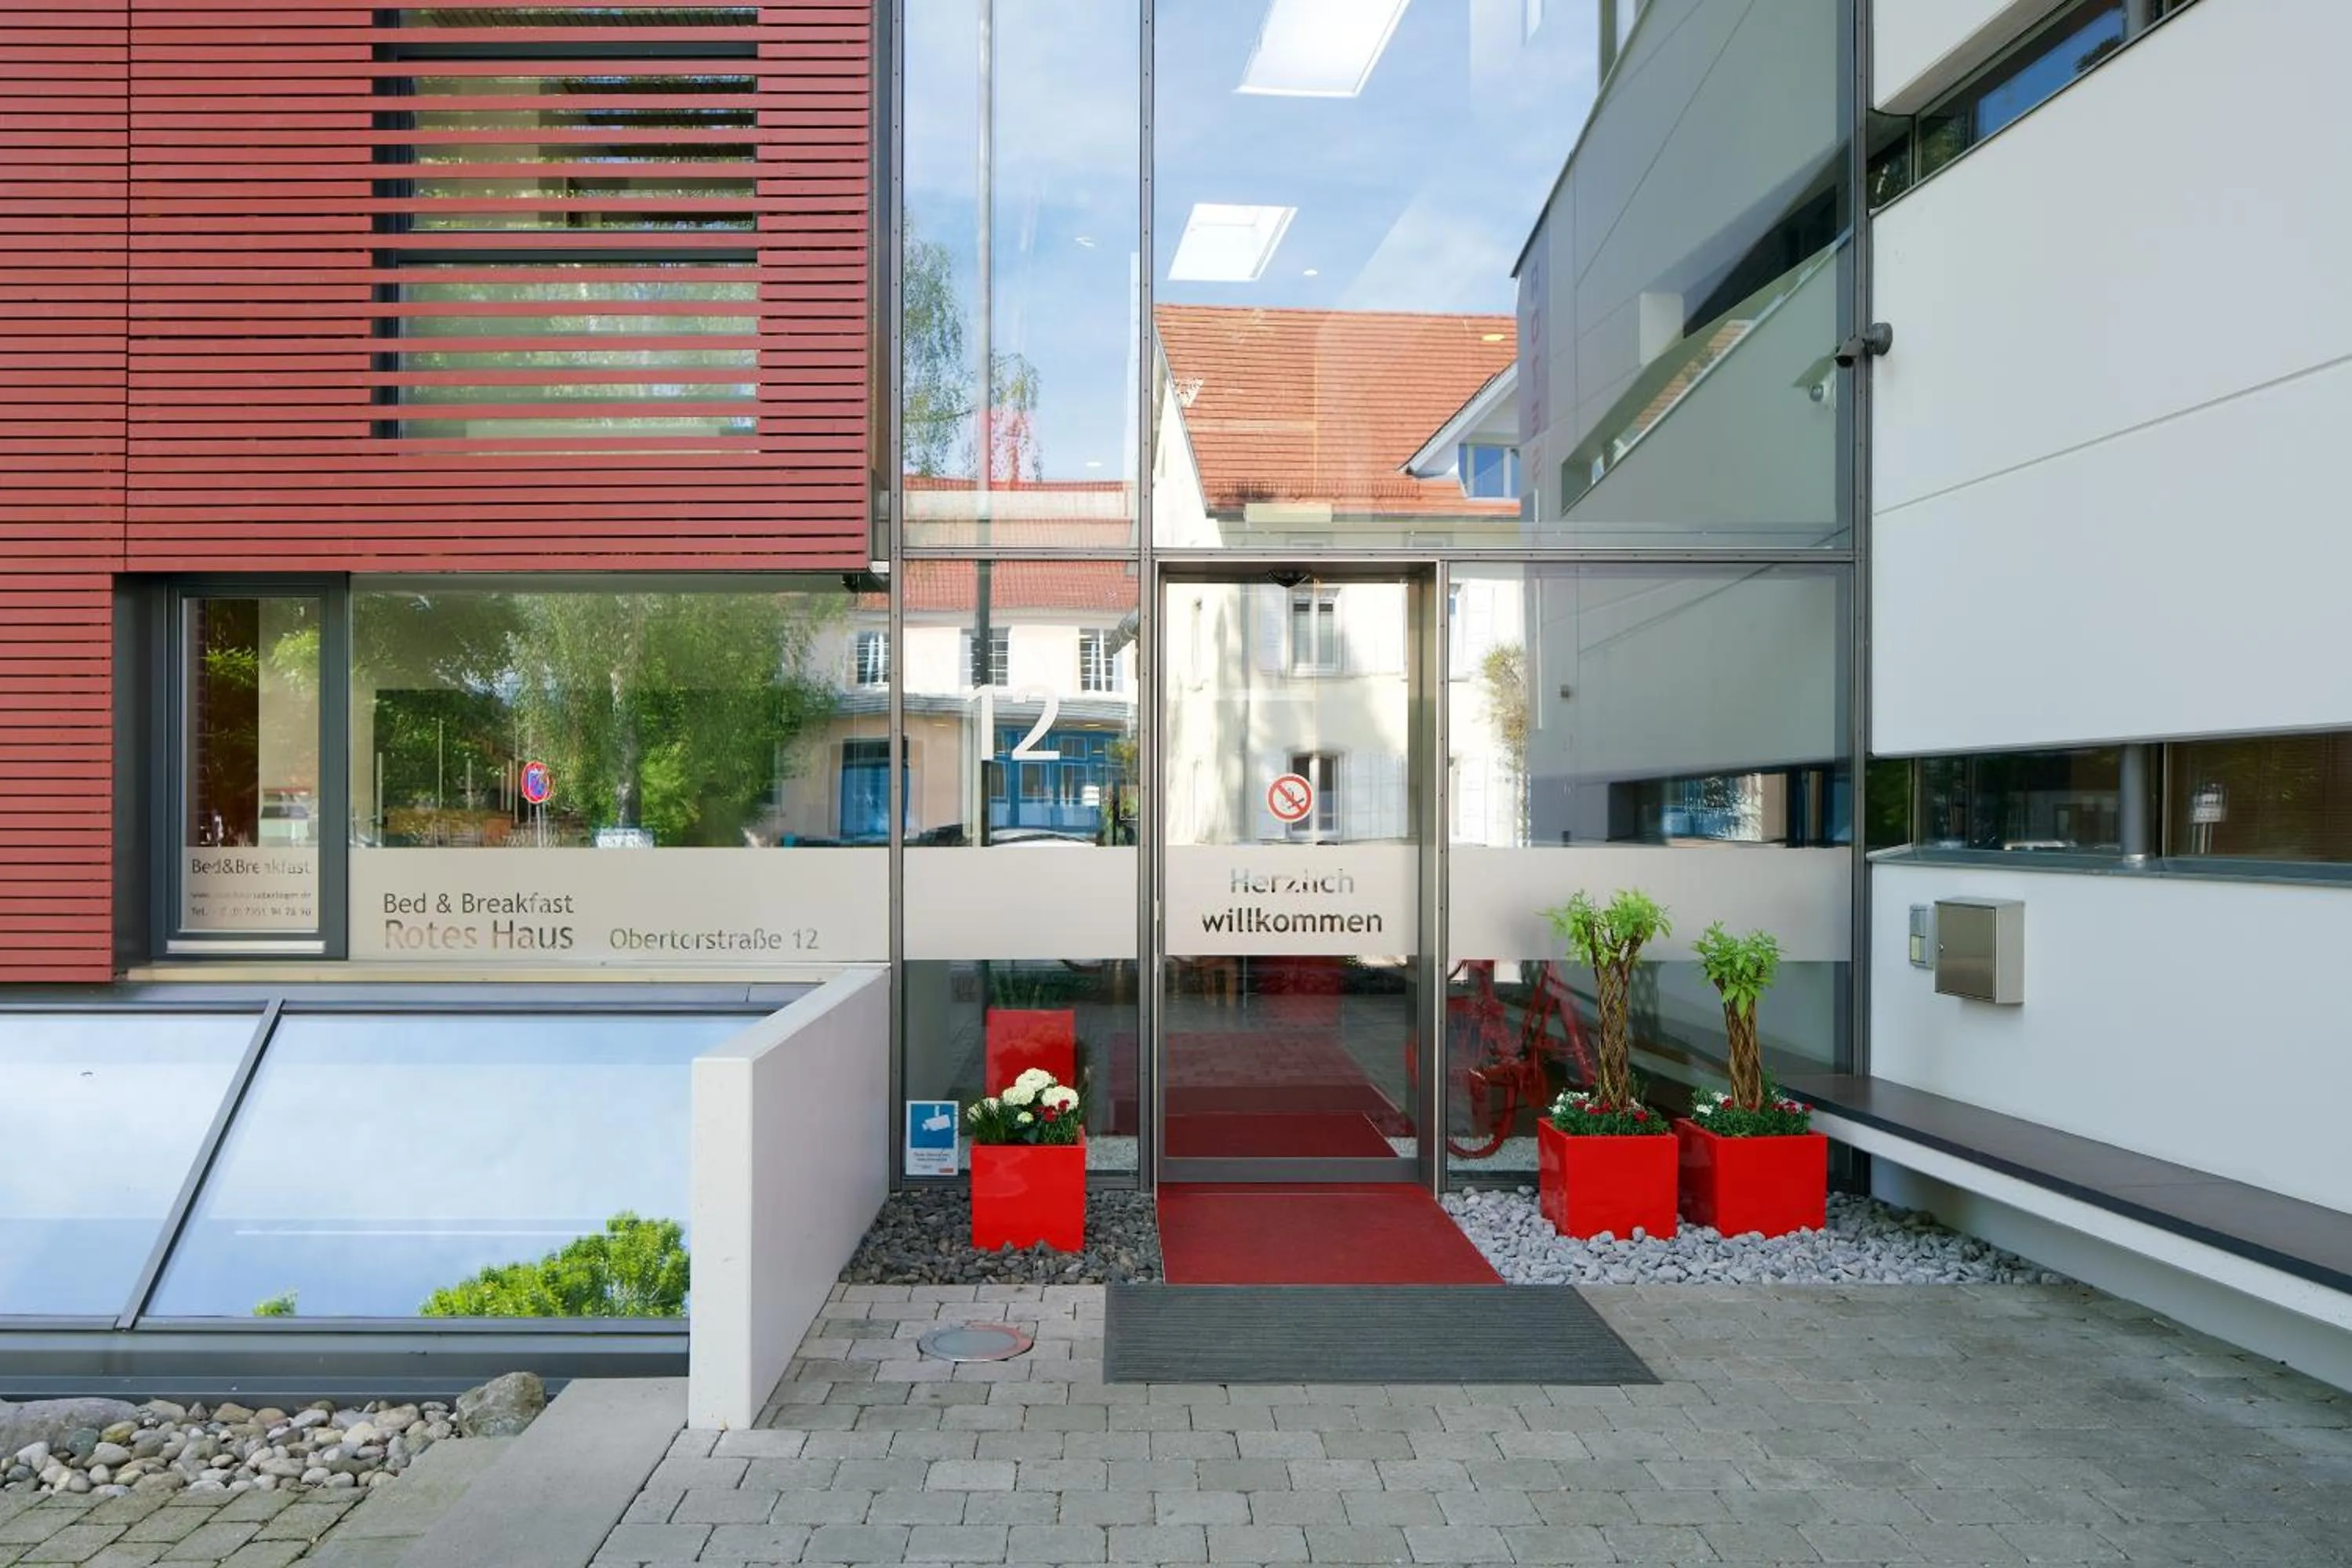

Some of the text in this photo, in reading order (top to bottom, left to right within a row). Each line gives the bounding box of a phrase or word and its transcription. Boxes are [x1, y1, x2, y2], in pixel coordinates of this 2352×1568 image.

[967, 684, 1061, 760] 12
[1230, 867, 1355, 894] Herzlich
[383, 892, 575, 913] Bed & Breakfast
[1202, 907, 1383, 933] willkommen
[384, 919, 574, 950] Rotes Haus
[609, 927, 820, 950] Obertorstraße 12
